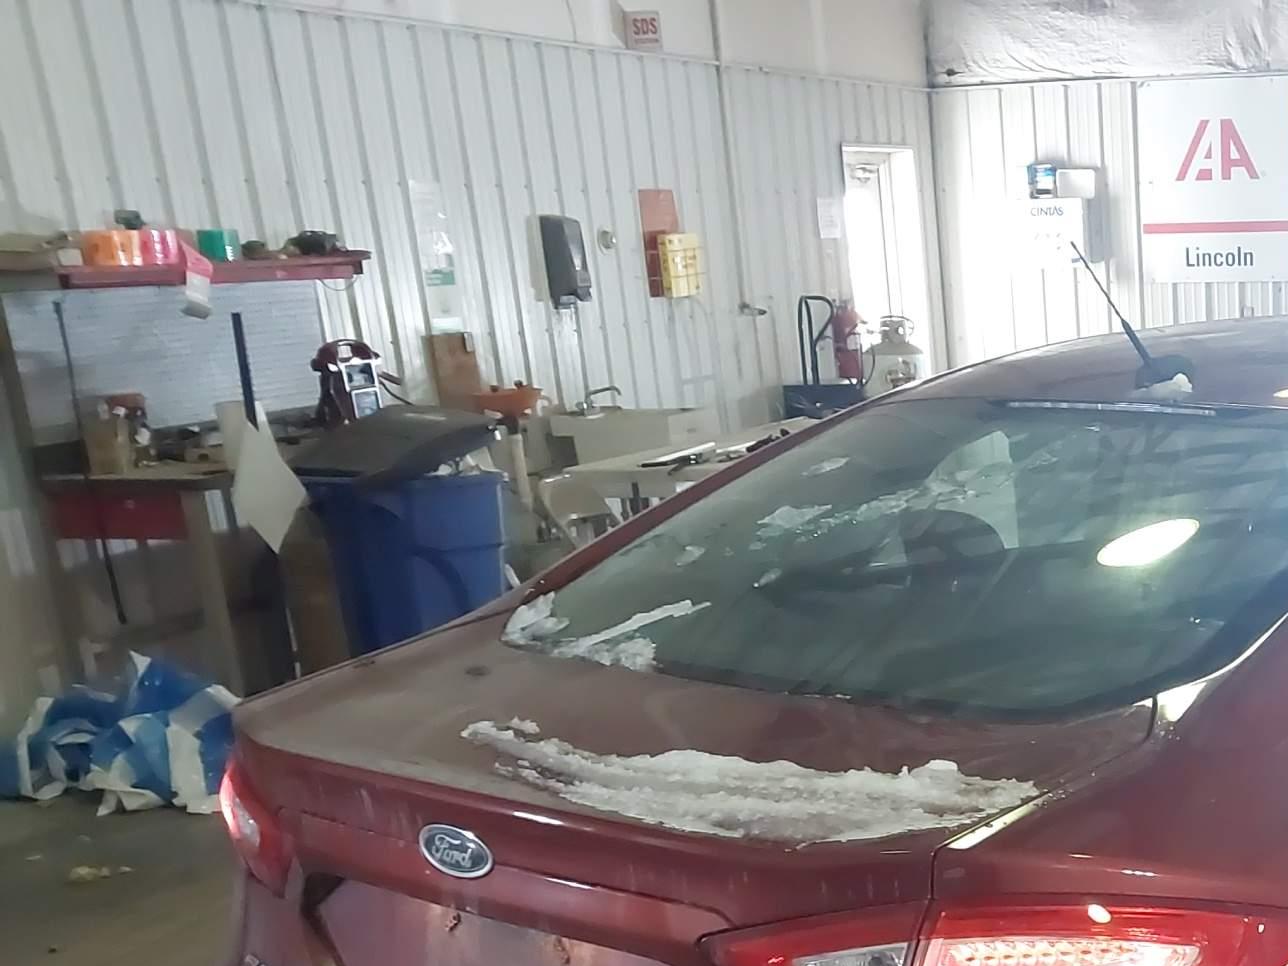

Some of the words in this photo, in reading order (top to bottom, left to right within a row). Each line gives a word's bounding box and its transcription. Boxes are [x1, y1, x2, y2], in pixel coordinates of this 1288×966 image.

[632, 17, 658, 35] SDS
[1030, 206, 1064, 217] CINTAS
[1185, 246, 1254, 267] Lincoln
[431, 834, 473, 868] Ford
